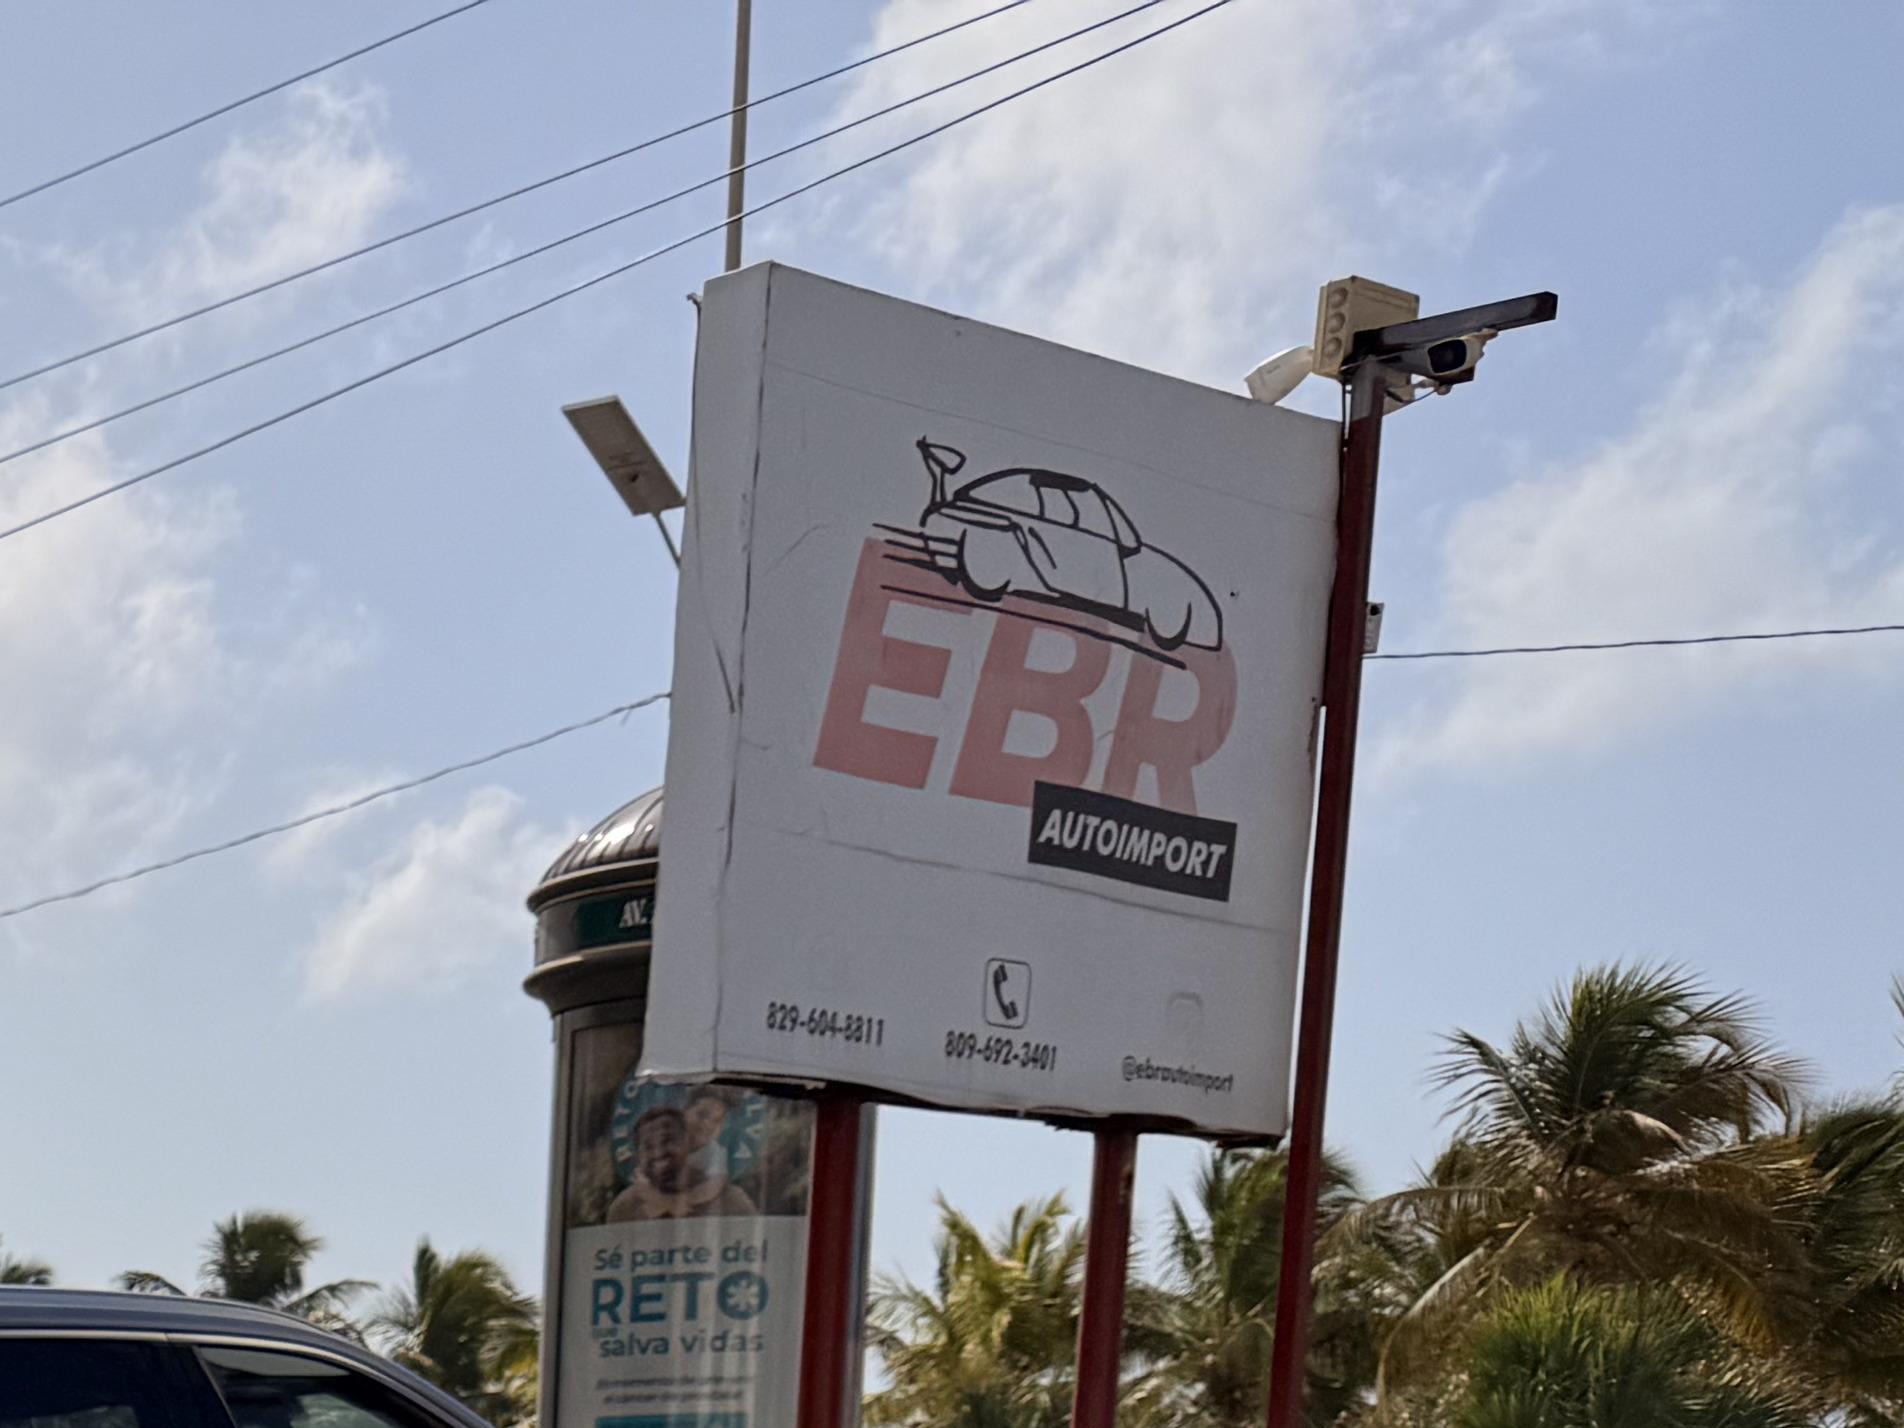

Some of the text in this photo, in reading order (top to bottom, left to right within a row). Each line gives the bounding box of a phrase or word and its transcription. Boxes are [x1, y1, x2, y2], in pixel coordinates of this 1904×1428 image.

[813, 537, 1238, 817] EBR
[1037, 808, 1228, 879] AUTOIMPORT
[766, 1001, 884, 1047] 829-604-8811
[945, 1029, 1057, 1072] 809-692-3401
[630, 1244, 712, 1273] parte
[721, 1238, 769, 1263] del
[591, 1270, 770, 1327] RETO
[599, 1332, 670, 1358] salva
[680, 1328, 765, 1354] vidas
